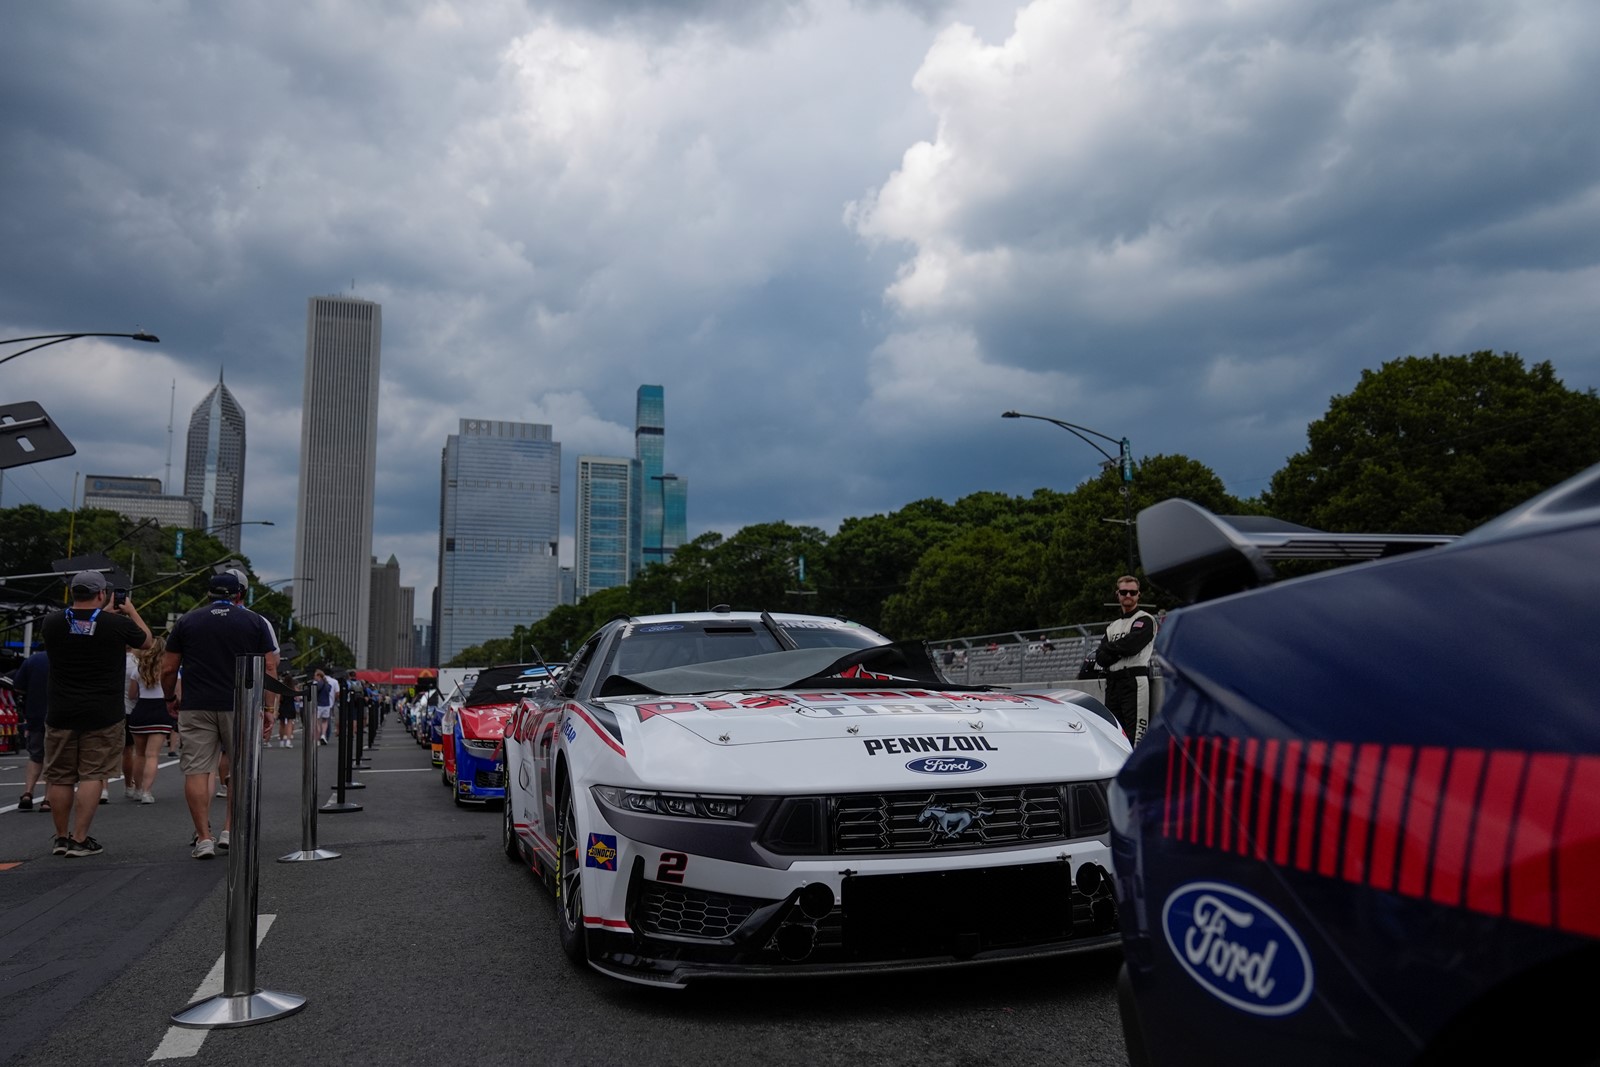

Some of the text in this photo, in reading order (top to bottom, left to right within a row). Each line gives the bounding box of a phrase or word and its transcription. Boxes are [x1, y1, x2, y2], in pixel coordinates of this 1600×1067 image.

[812, 704, 963, 716] TIRE
[863, 736, 998, 756] PENNZOIL
[923, 758, 972, 773] Ford
[589, 846, 616, 859] SUNOCO
[656, 852, 688, 884] 2
[1184, 893, 1280, 999] Ford
